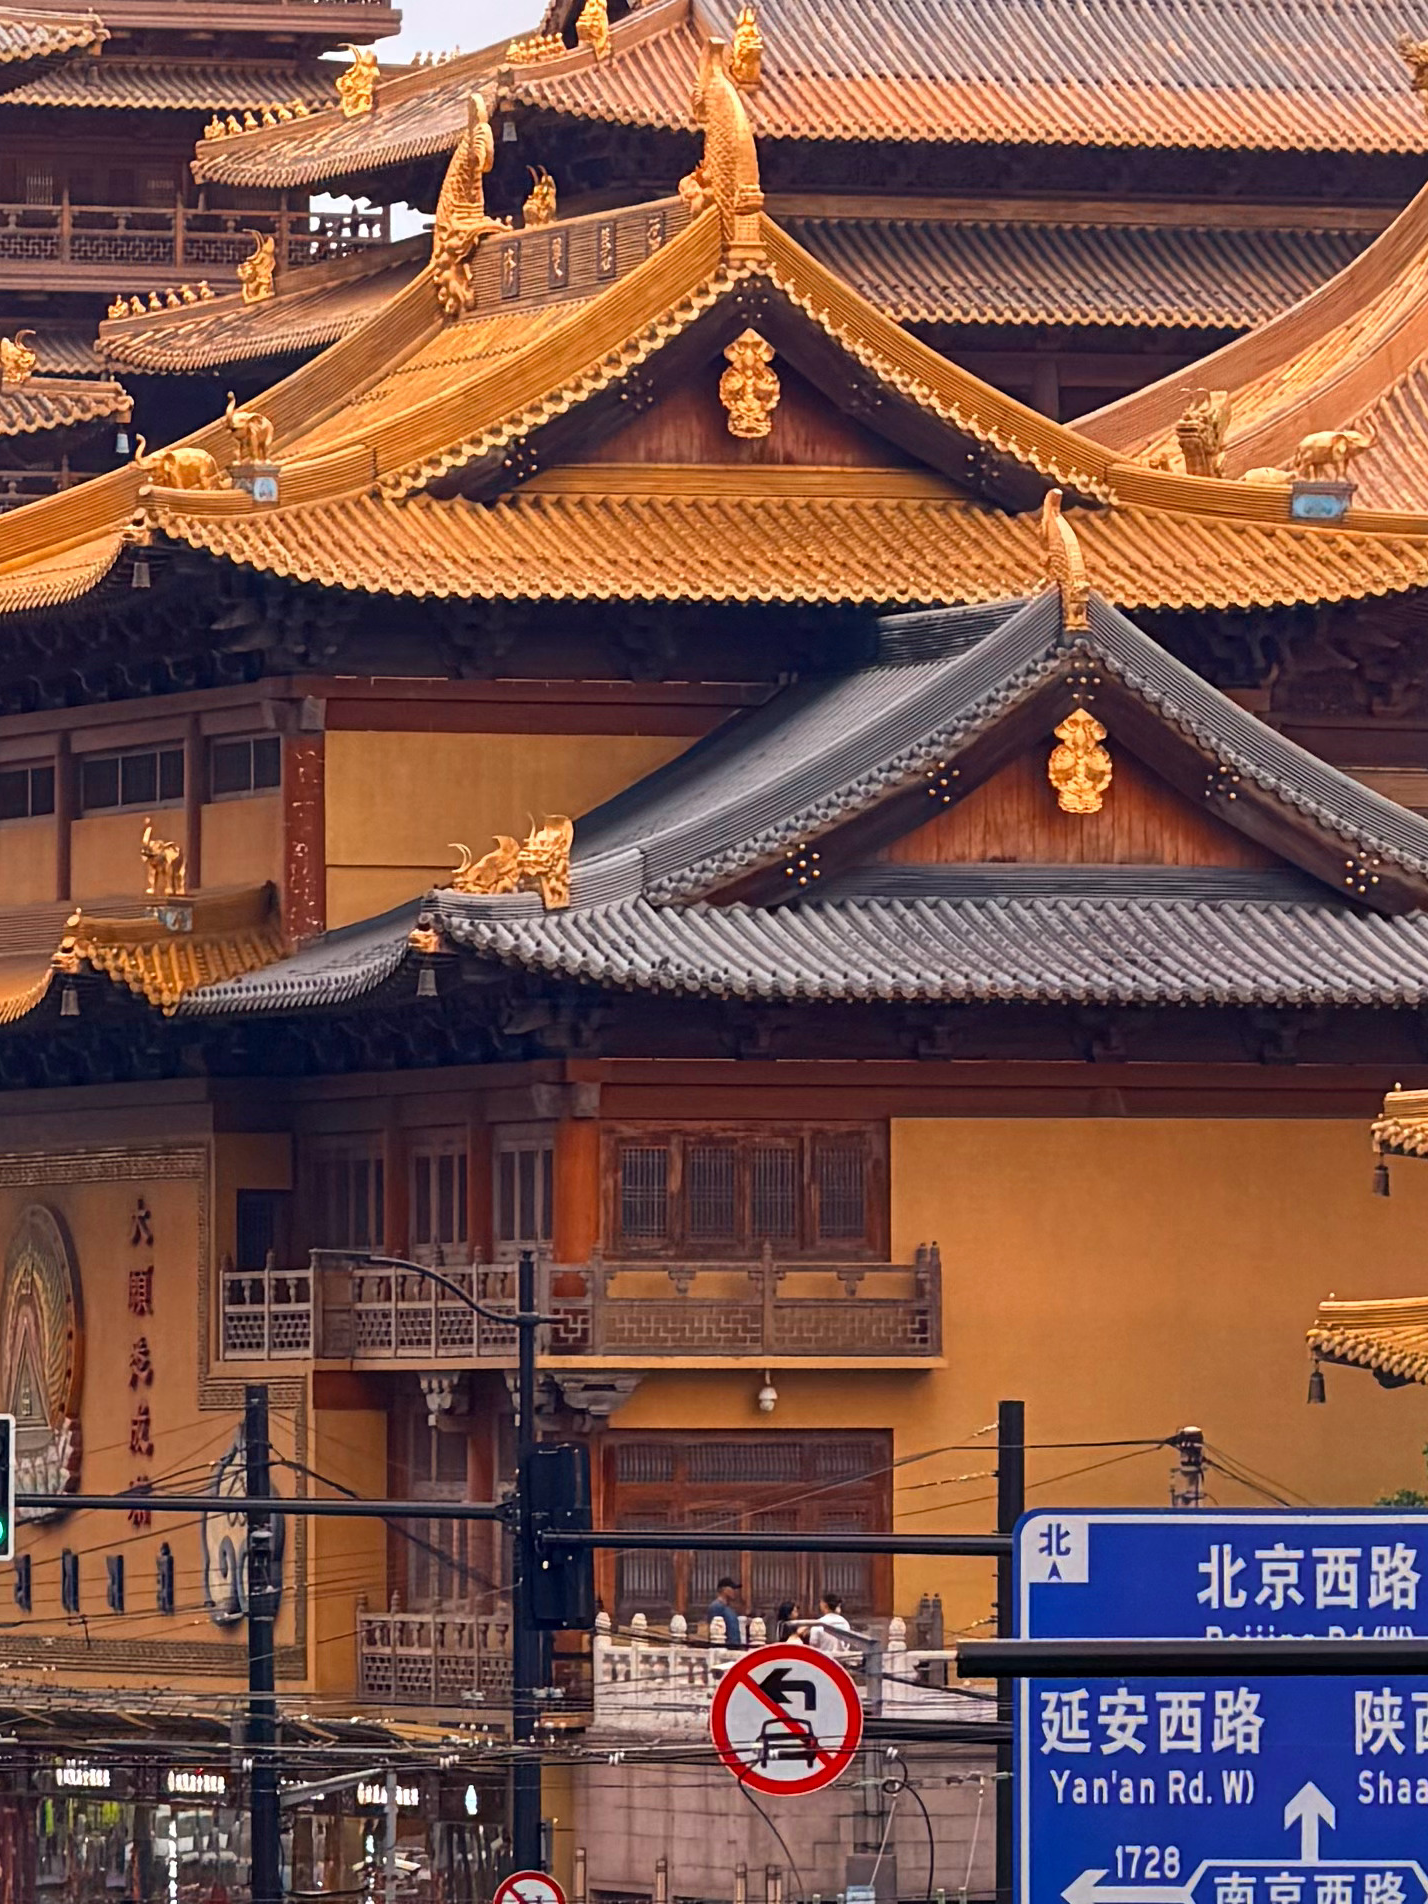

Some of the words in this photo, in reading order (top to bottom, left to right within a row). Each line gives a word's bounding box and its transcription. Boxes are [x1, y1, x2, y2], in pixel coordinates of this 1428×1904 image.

[1037, 1523, 1072, 1558] 北
[1197, 1542, 1421, 1611] 北京西路
[1039, 1686, 1266, 1756] 延安西路
[1050, 1769, 1155, 1804] Yan'an
[1115, 1845, 1181, 1879] 1728
